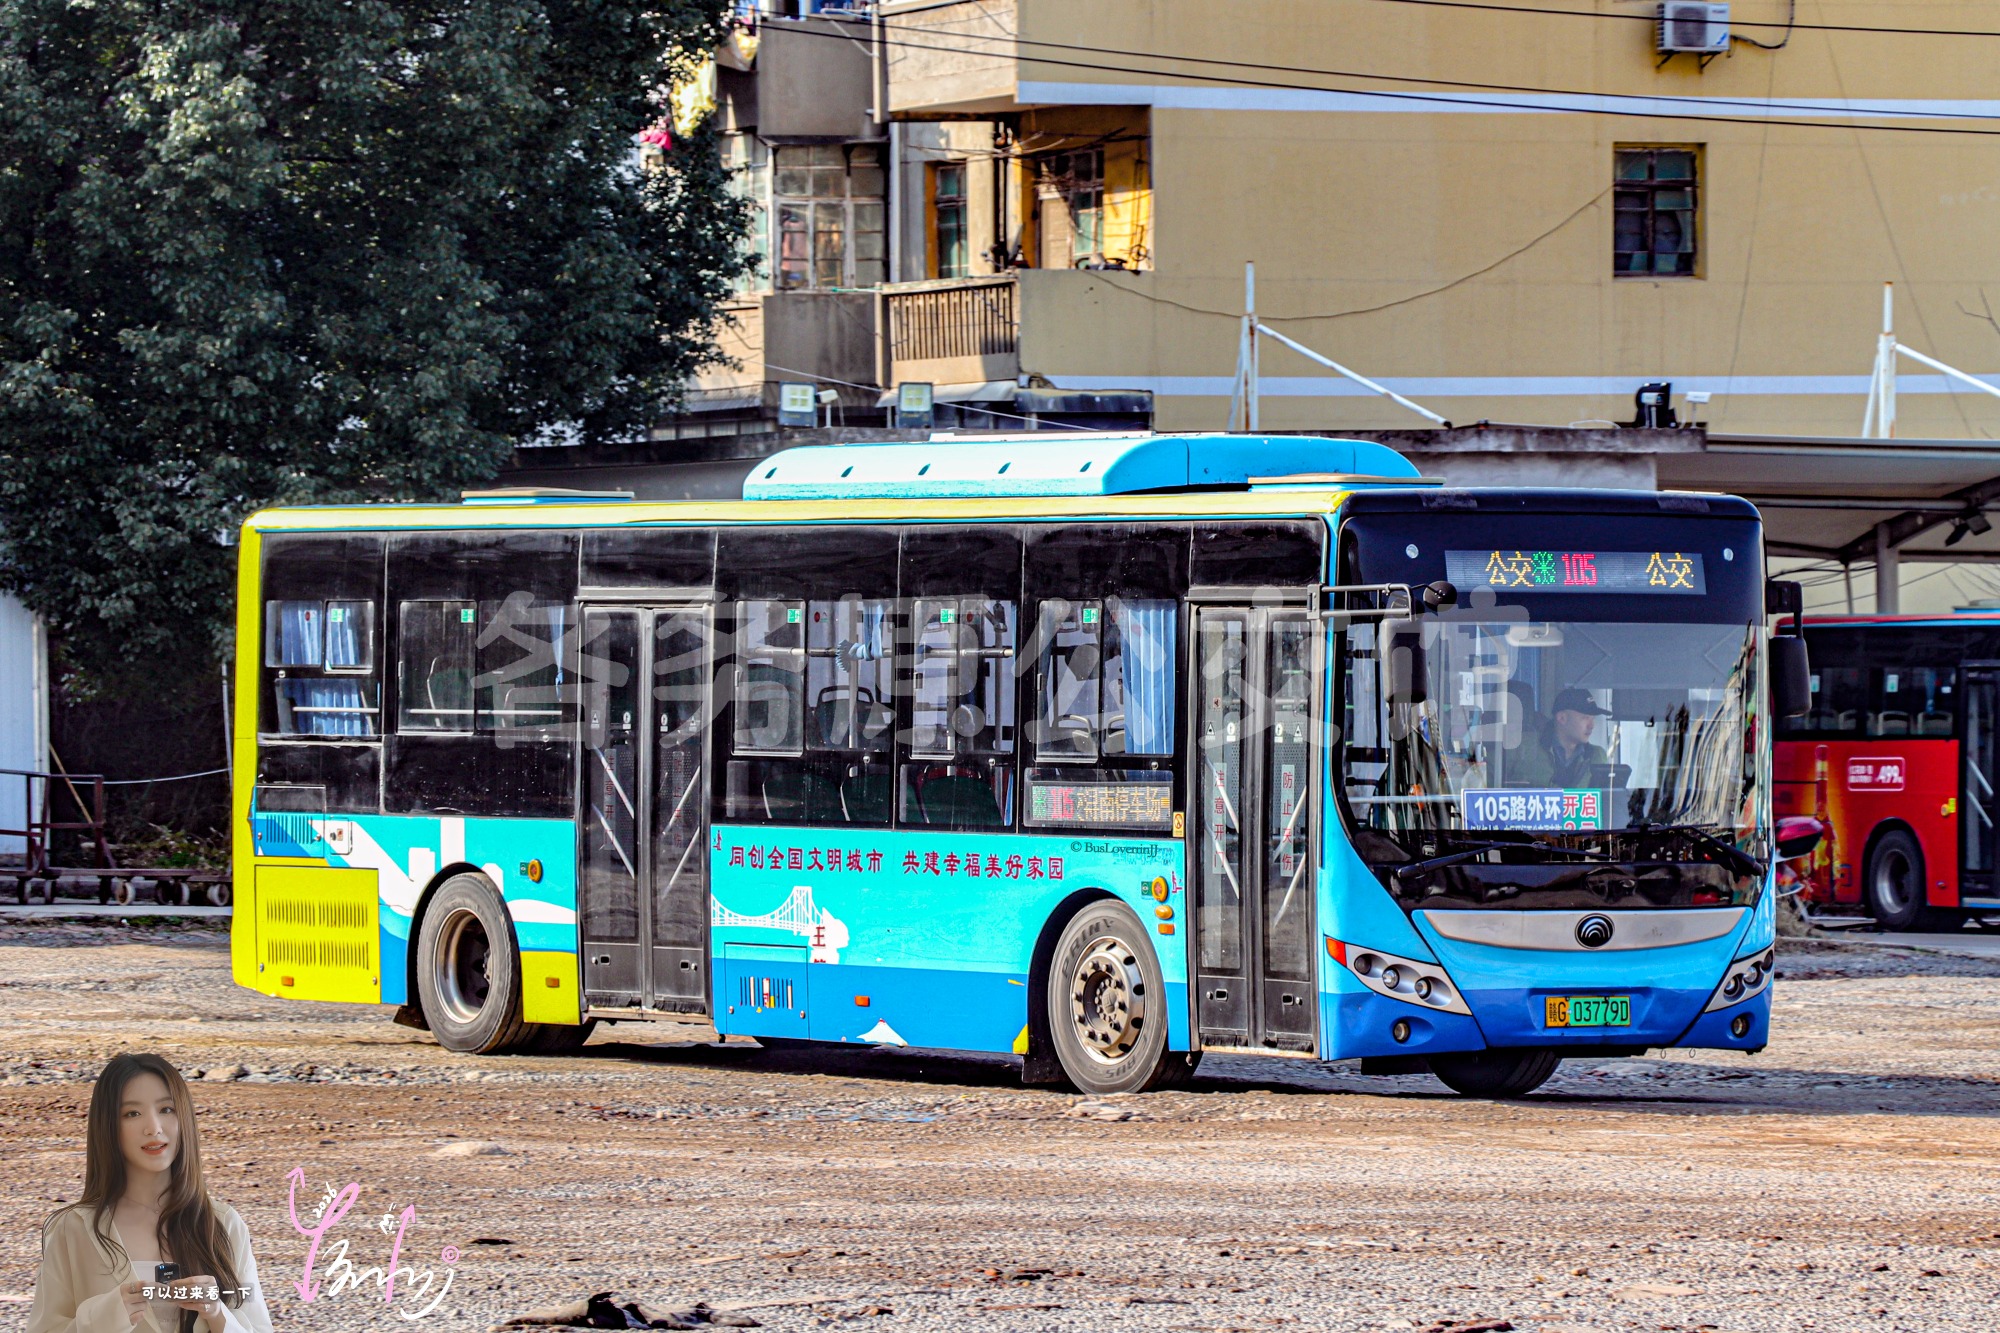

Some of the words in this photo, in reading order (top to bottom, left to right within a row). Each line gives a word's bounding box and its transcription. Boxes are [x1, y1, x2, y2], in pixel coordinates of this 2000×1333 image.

[1485, 551, 1534, 587] 公交
[1561, 553, 1598, 586] 105
[1646, 552, 1695, 589] 公交
[1474, 795, 1562, 822] 105路外环
[729, 845, 883, 873] 同创全国文明城市
[902, 850, 1064, 880] 共建幸福美好家园
